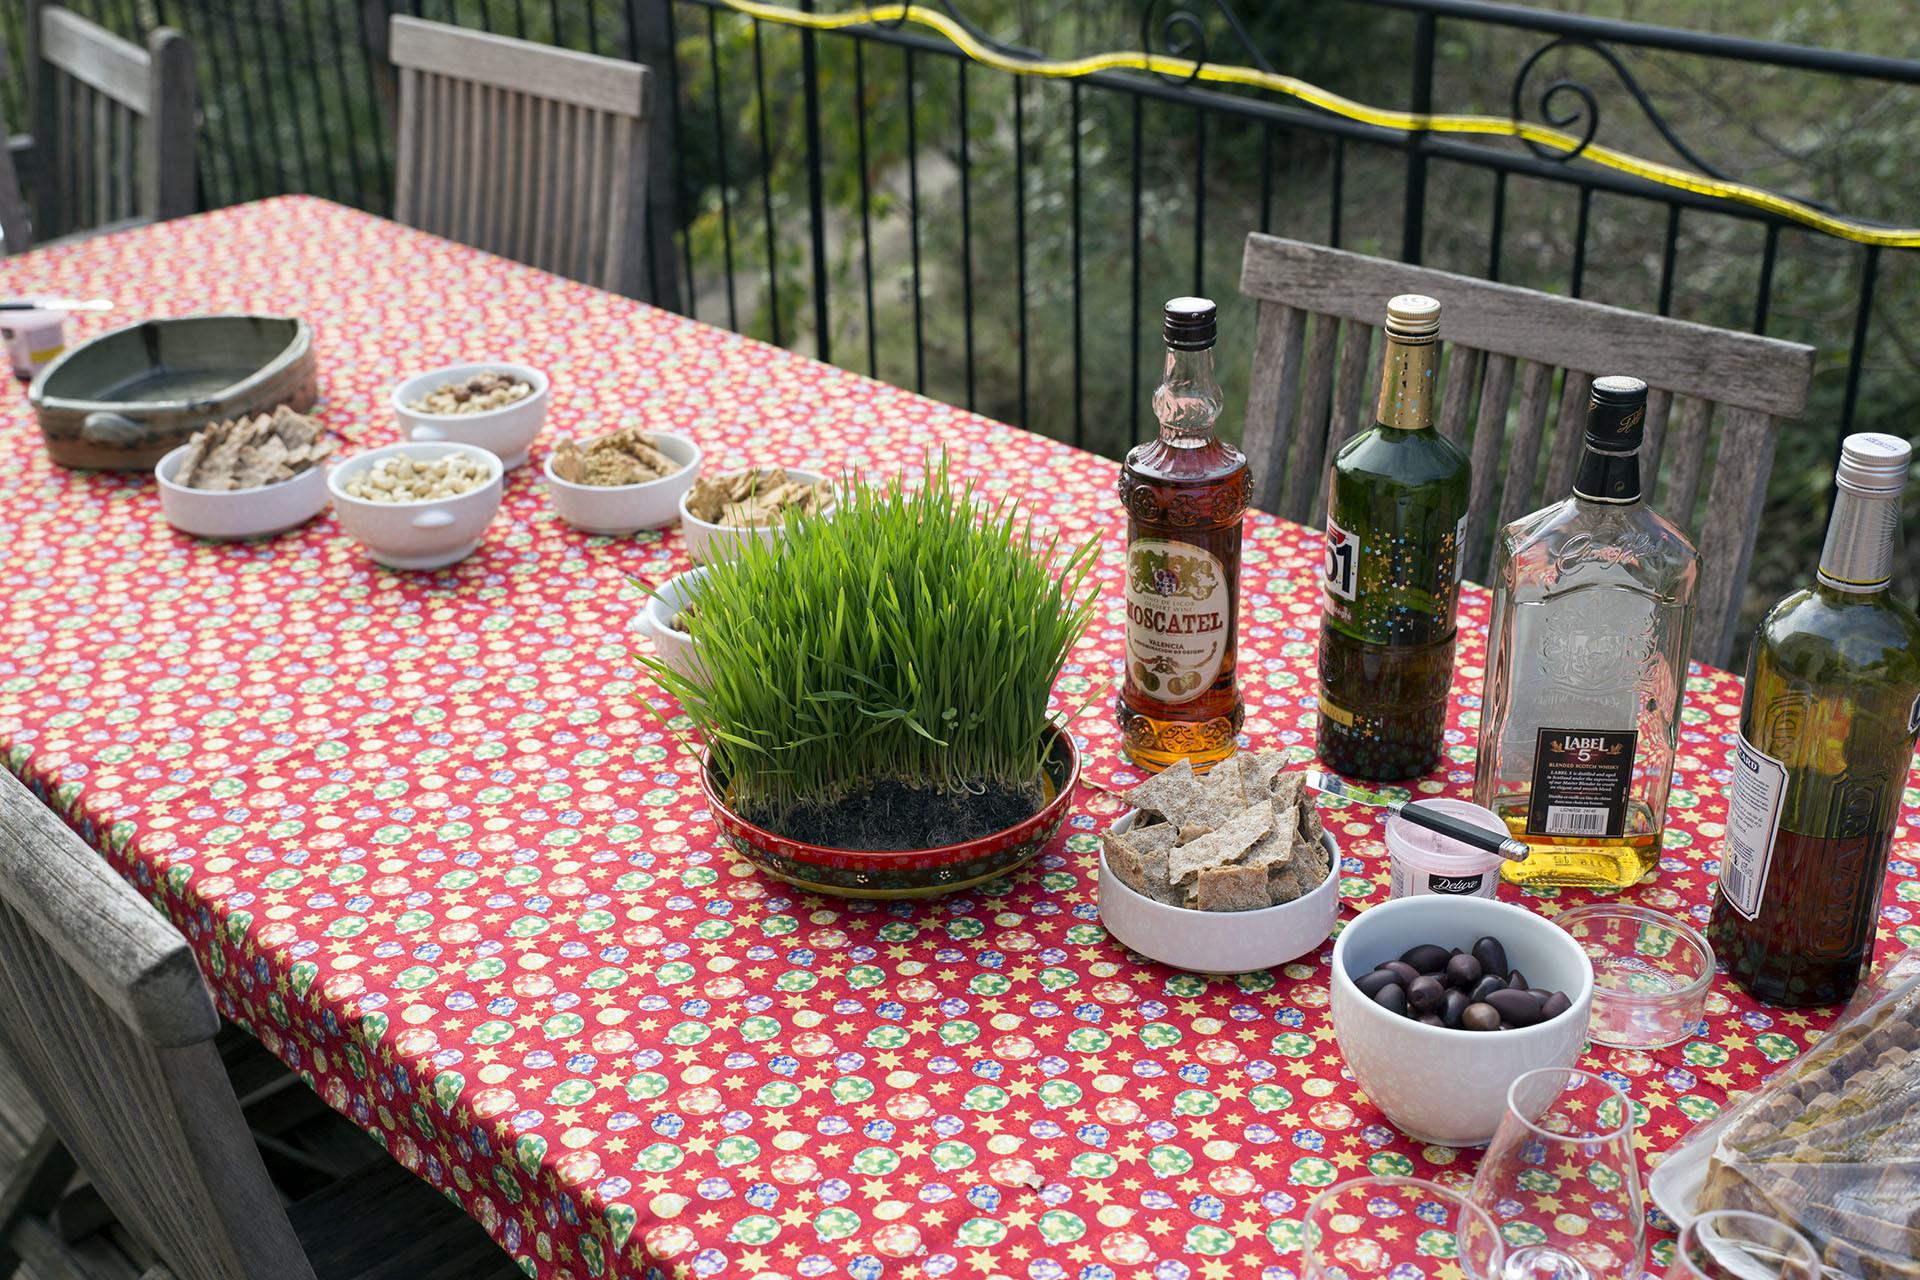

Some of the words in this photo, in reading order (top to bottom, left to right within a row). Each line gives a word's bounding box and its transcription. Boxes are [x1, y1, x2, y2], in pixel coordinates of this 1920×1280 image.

[1325, 531, 1352, 593] 51
[1126, 598, 1223, 634] MOSCATEL
[1148, 638, 1184, 650] VALENCIA
[1564, 736, 1609, 752] LABEL
[1577, 748, 1591, 762] 5
[1737, 748, 1758, 771] CARD
[1432, 878, 1478, 892] Deluxe
